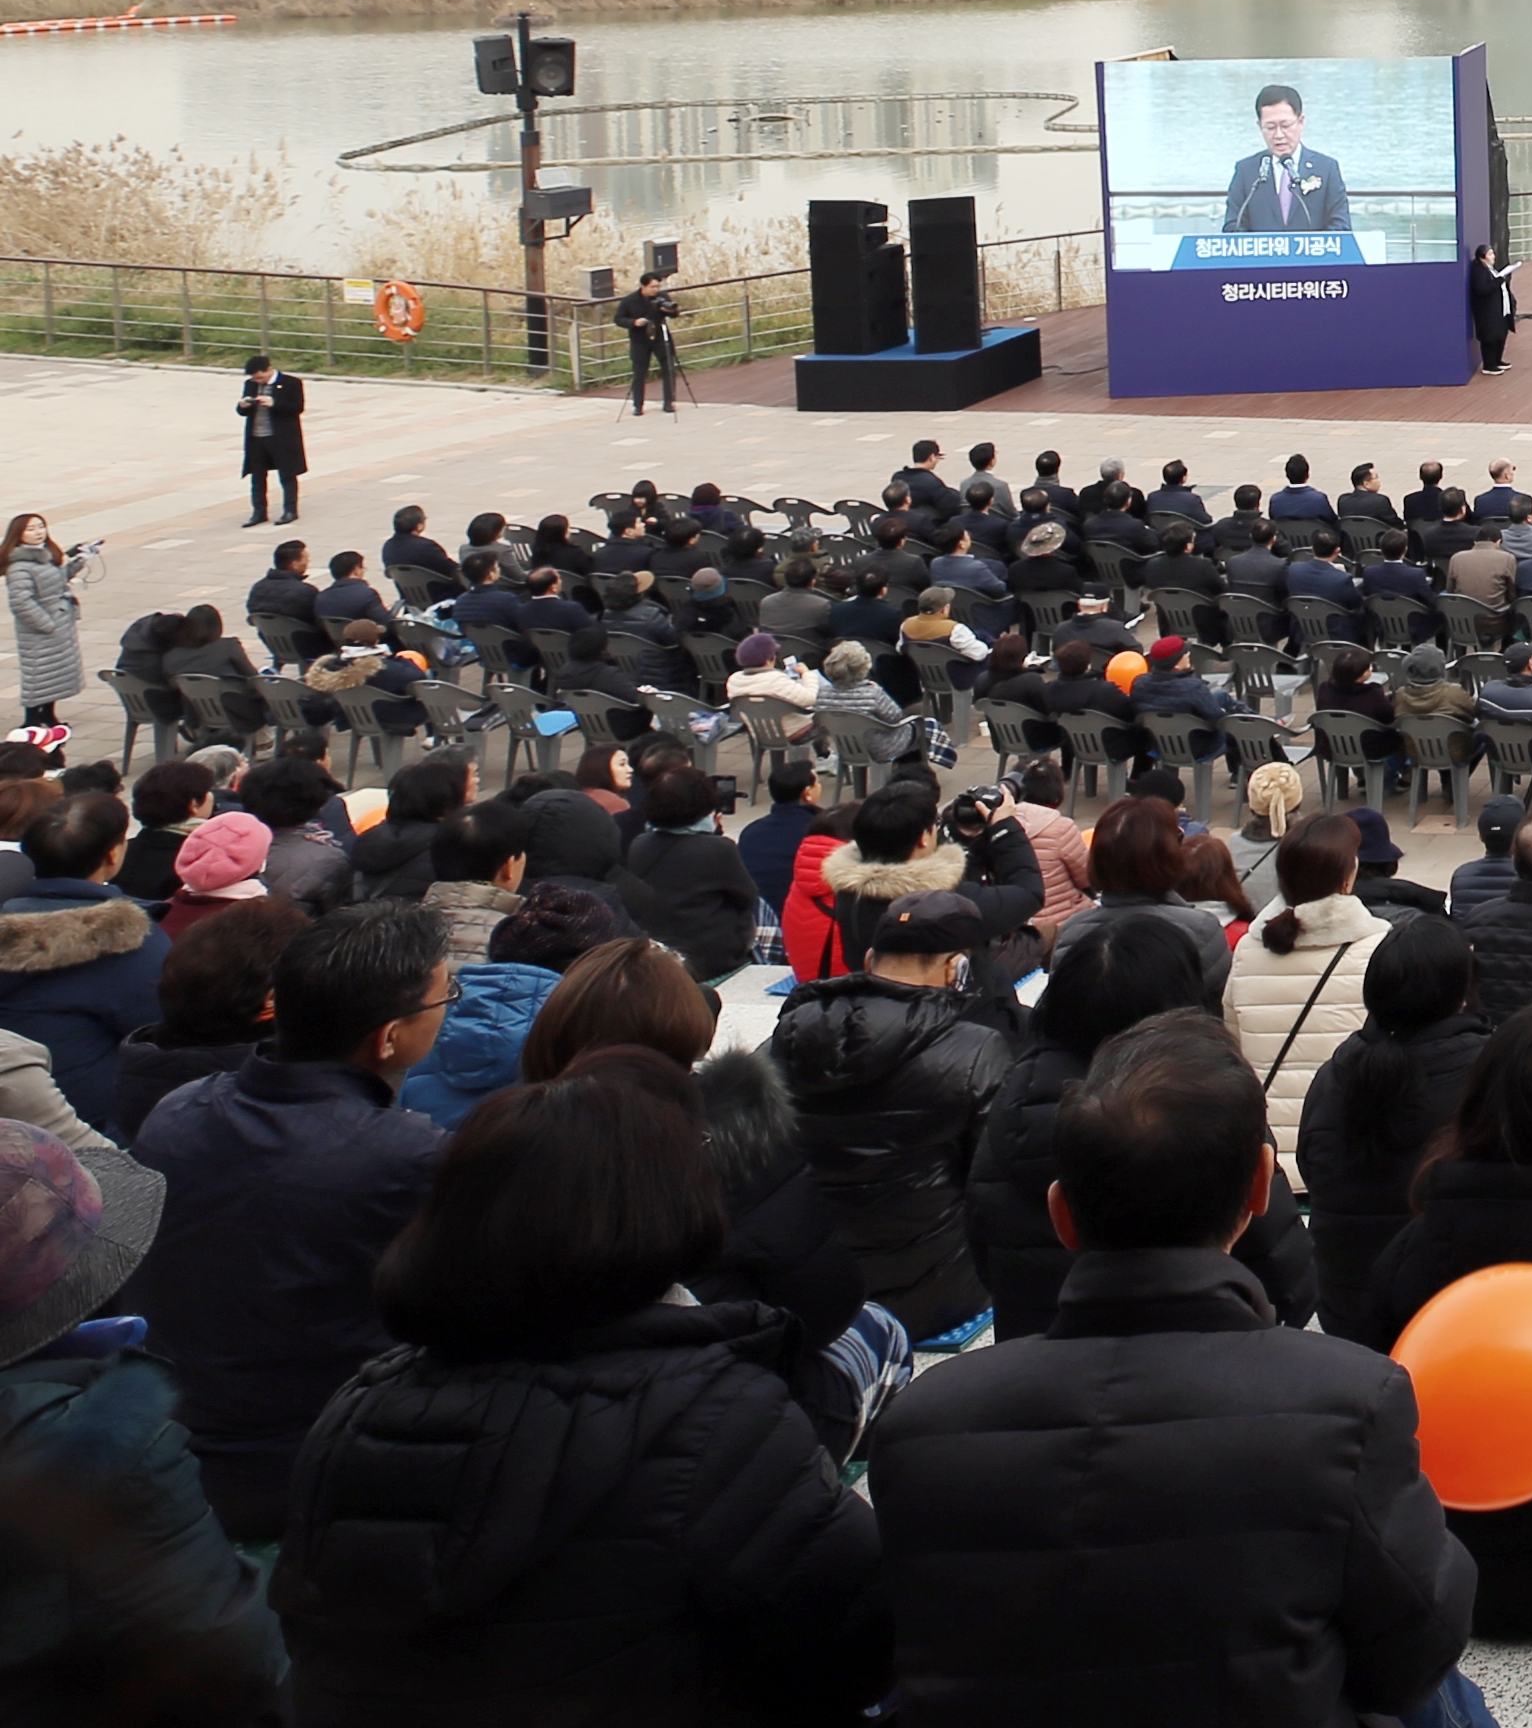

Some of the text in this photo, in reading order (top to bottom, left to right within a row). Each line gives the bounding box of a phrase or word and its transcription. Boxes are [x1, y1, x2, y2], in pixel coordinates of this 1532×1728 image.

[1195, 235, 1342, 258] 청라시티타워 기공식
[1221, 280, 1349, 302] 청라시티타워(주)
